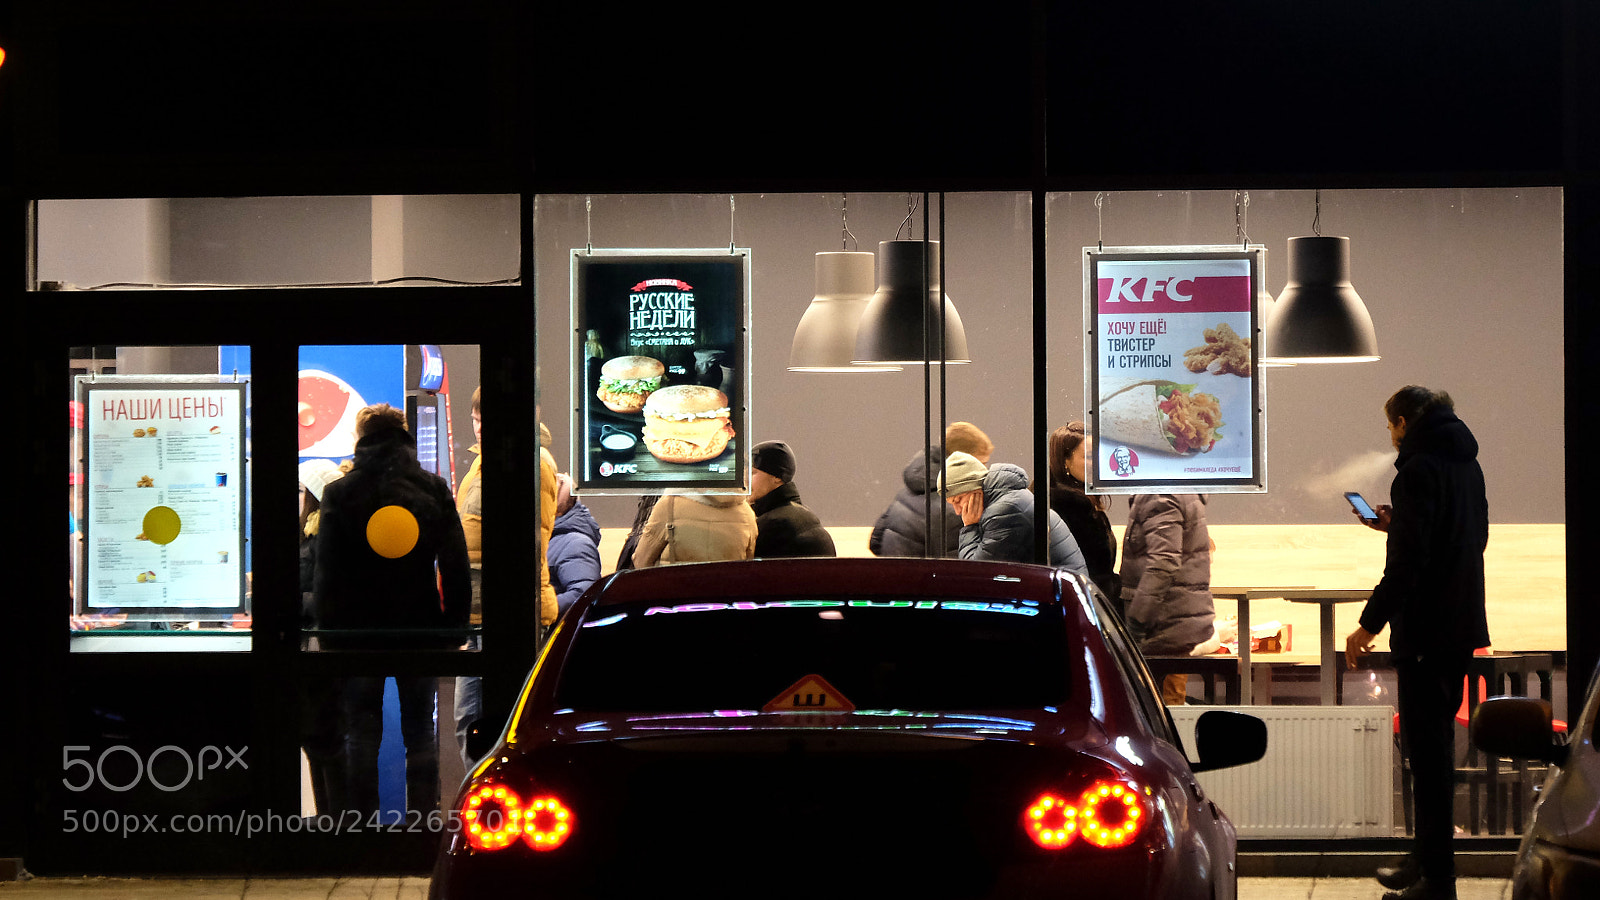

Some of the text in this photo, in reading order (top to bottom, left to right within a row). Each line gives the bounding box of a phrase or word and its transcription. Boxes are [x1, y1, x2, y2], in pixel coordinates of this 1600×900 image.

[1105, 276, 1195, 303] KFC
[629, 292, 695, 312] РУССКИЕ
[629, 310, 695, 330] НЕДЕЛИ
[1107, 318, 1167, 337] ХОЧУ ЕЩЁ!
[1107, 338, 1156, 352] ТВИСТЕР
[1107, 354, 1172, 369] И СТРИПСЫ
[102, 396, 224, 422] НАШИ ЦЕНЫ
[613, 464, 638, 475] KFC
[793, 693, 826, 707] Ш
